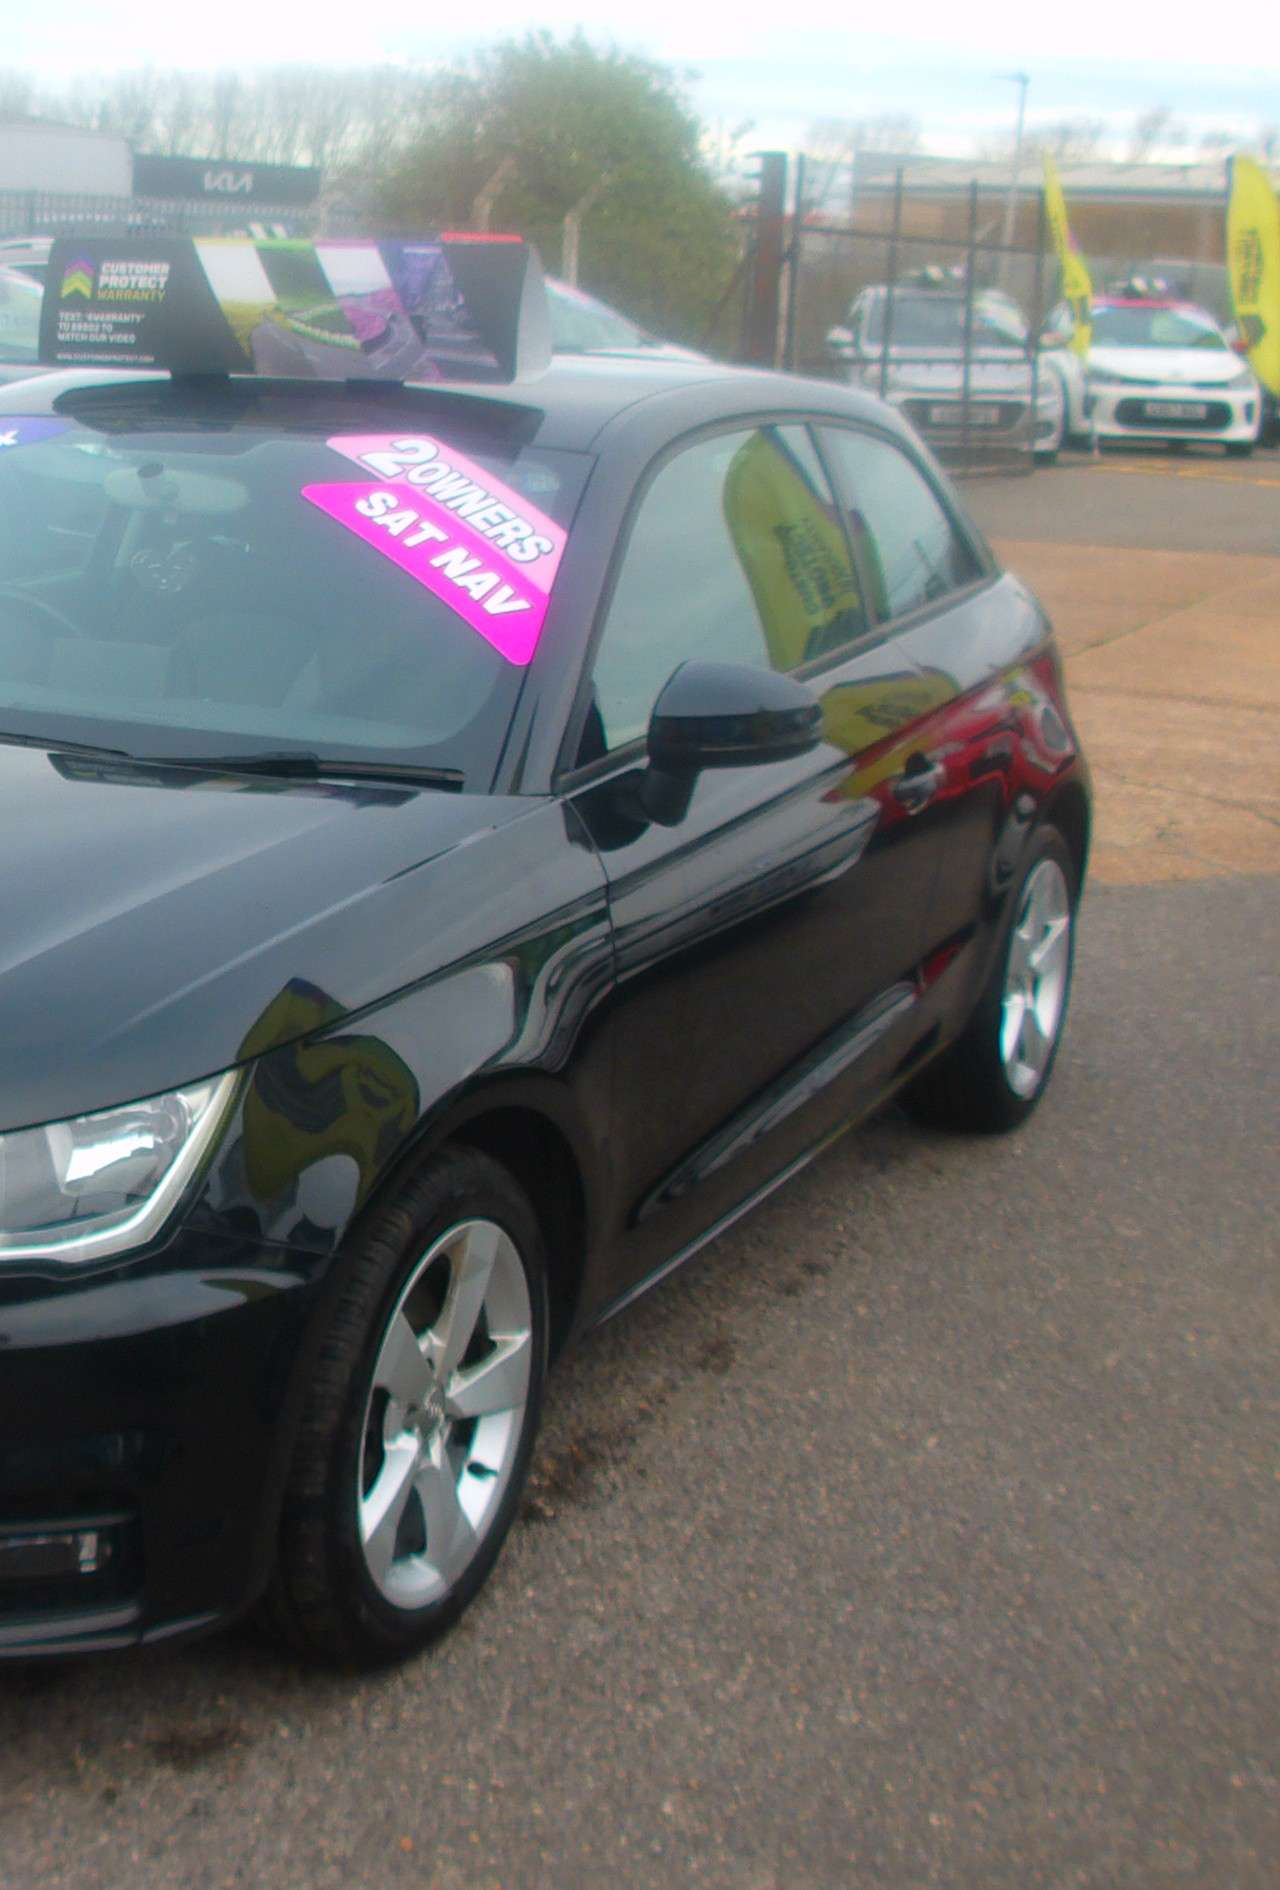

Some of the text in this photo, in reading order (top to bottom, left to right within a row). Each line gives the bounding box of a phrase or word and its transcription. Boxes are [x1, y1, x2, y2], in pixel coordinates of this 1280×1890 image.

[203, 171, 254, 193] KIA
[101, 261, 170, 275] CUSTOMER
[99, 274, 168, 289] PROTECT
[96, 288, 166, 302] WARRANTY
[88, 332, 108, 343] OUR
[109, 333, 136, 344] VIDEO
[357, 438, 555, 563] 2 OWNERS
[354, 491, 532, 616] SAT NAV
